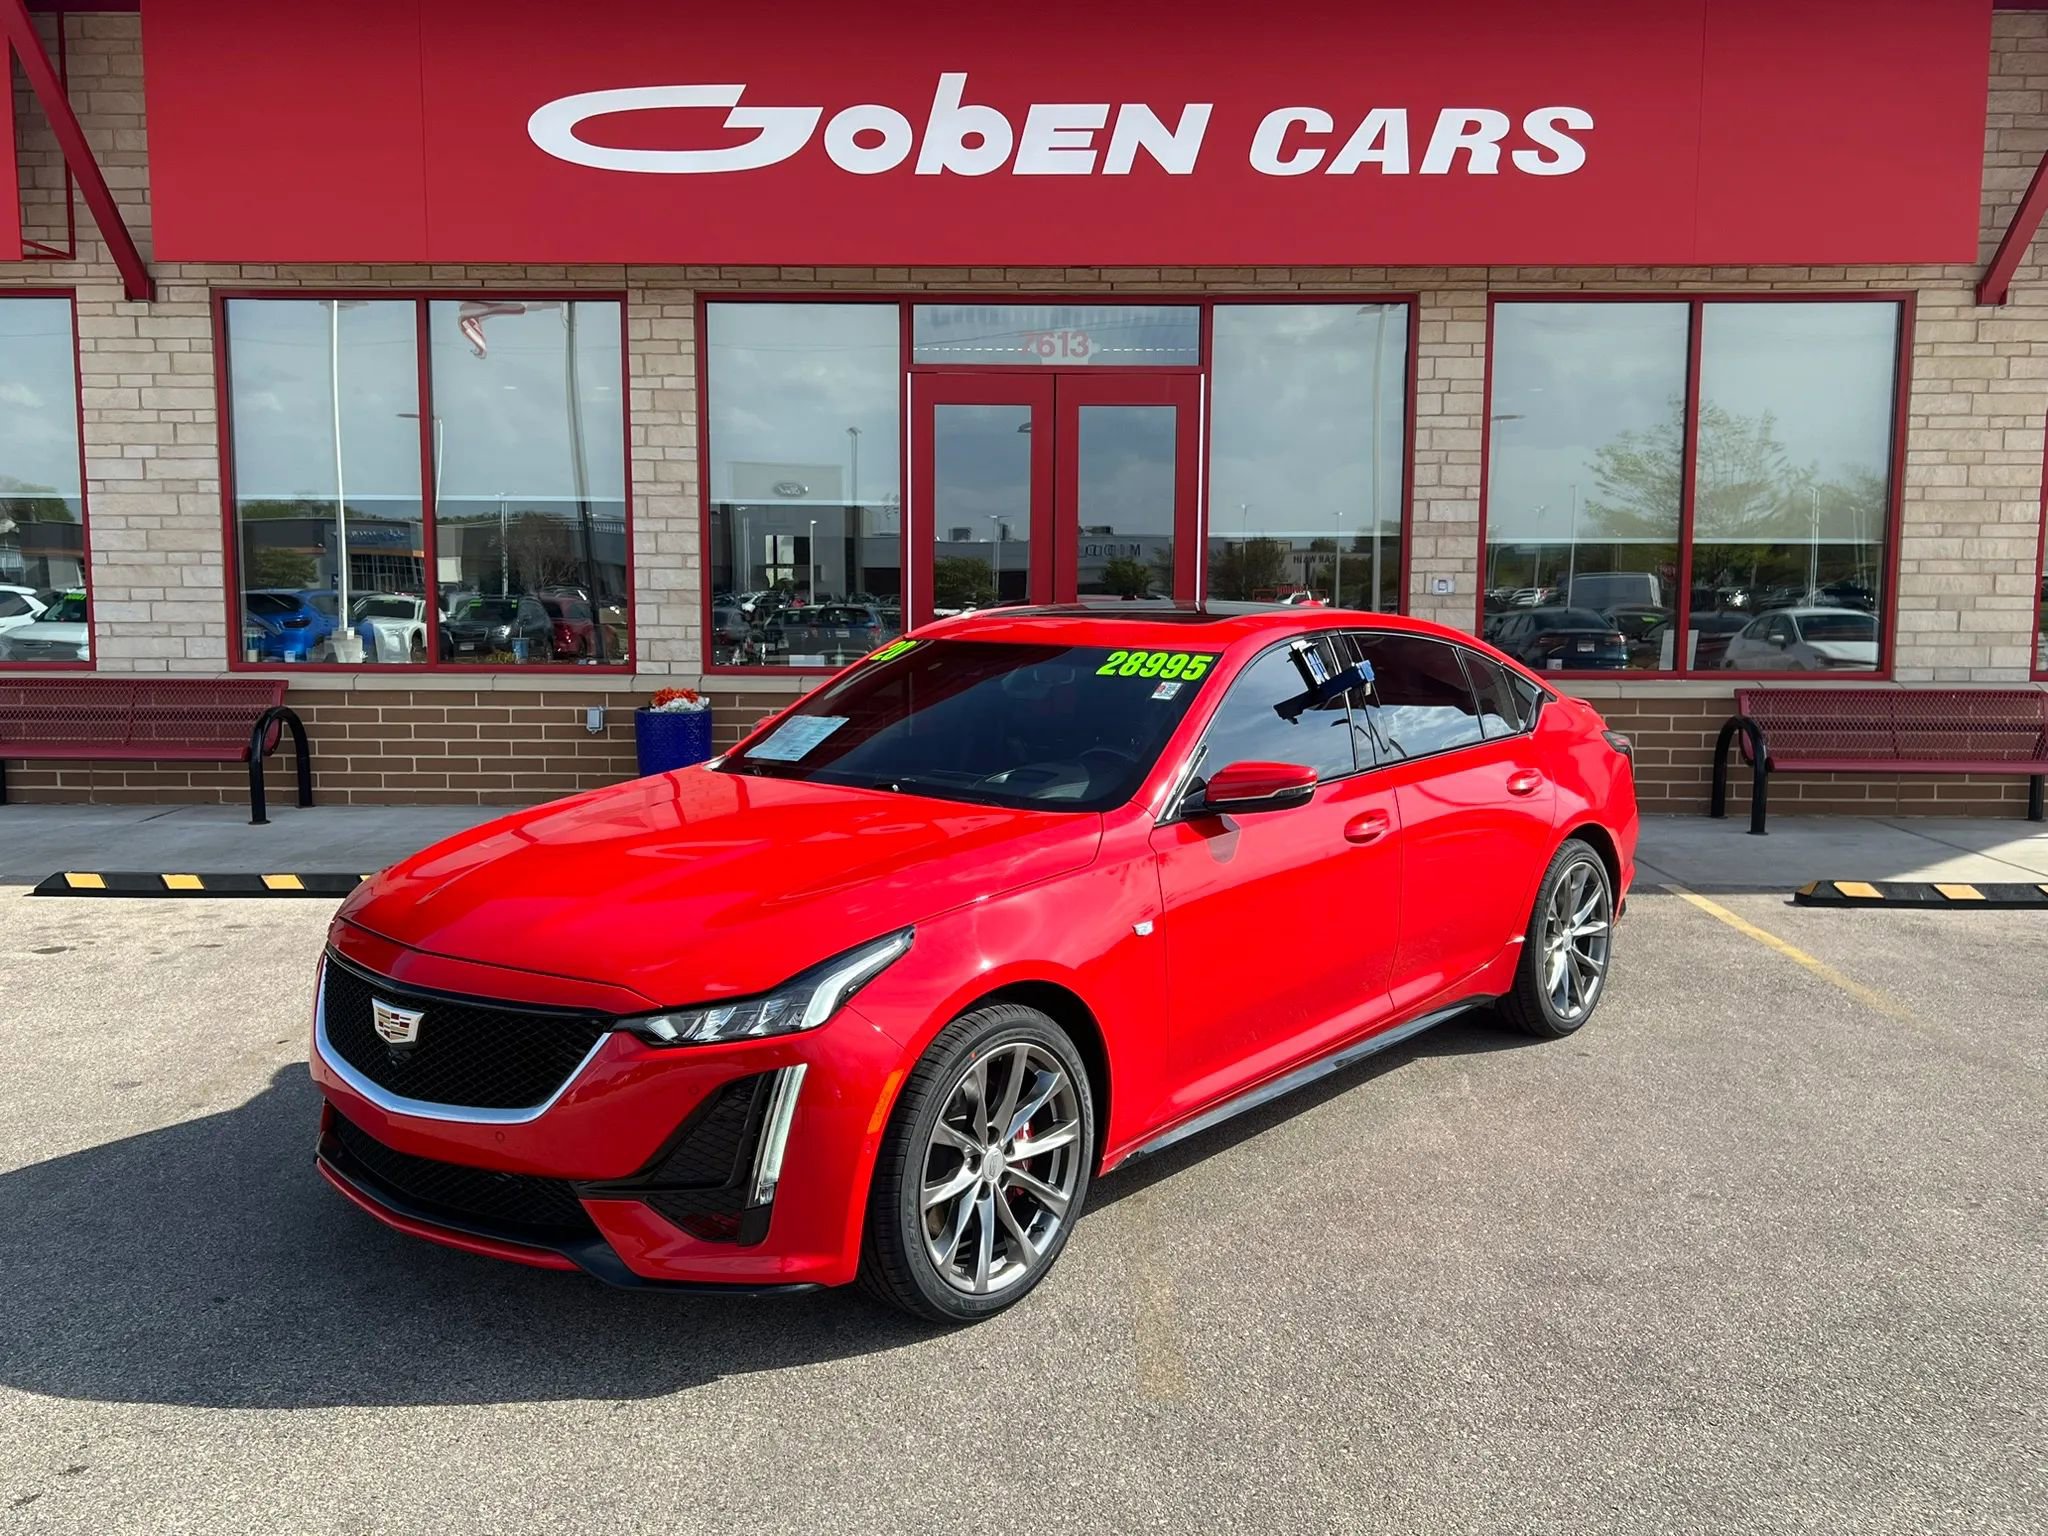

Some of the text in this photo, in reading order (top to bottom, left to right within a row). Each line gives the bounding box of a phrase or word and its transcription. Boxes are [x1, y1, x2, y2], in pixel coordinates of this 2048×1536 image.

[1249, 107, 1594, 176] CARS
[1018, 331, 1089, 358] 7613
[1095, 651, 1214, 681] 28995
